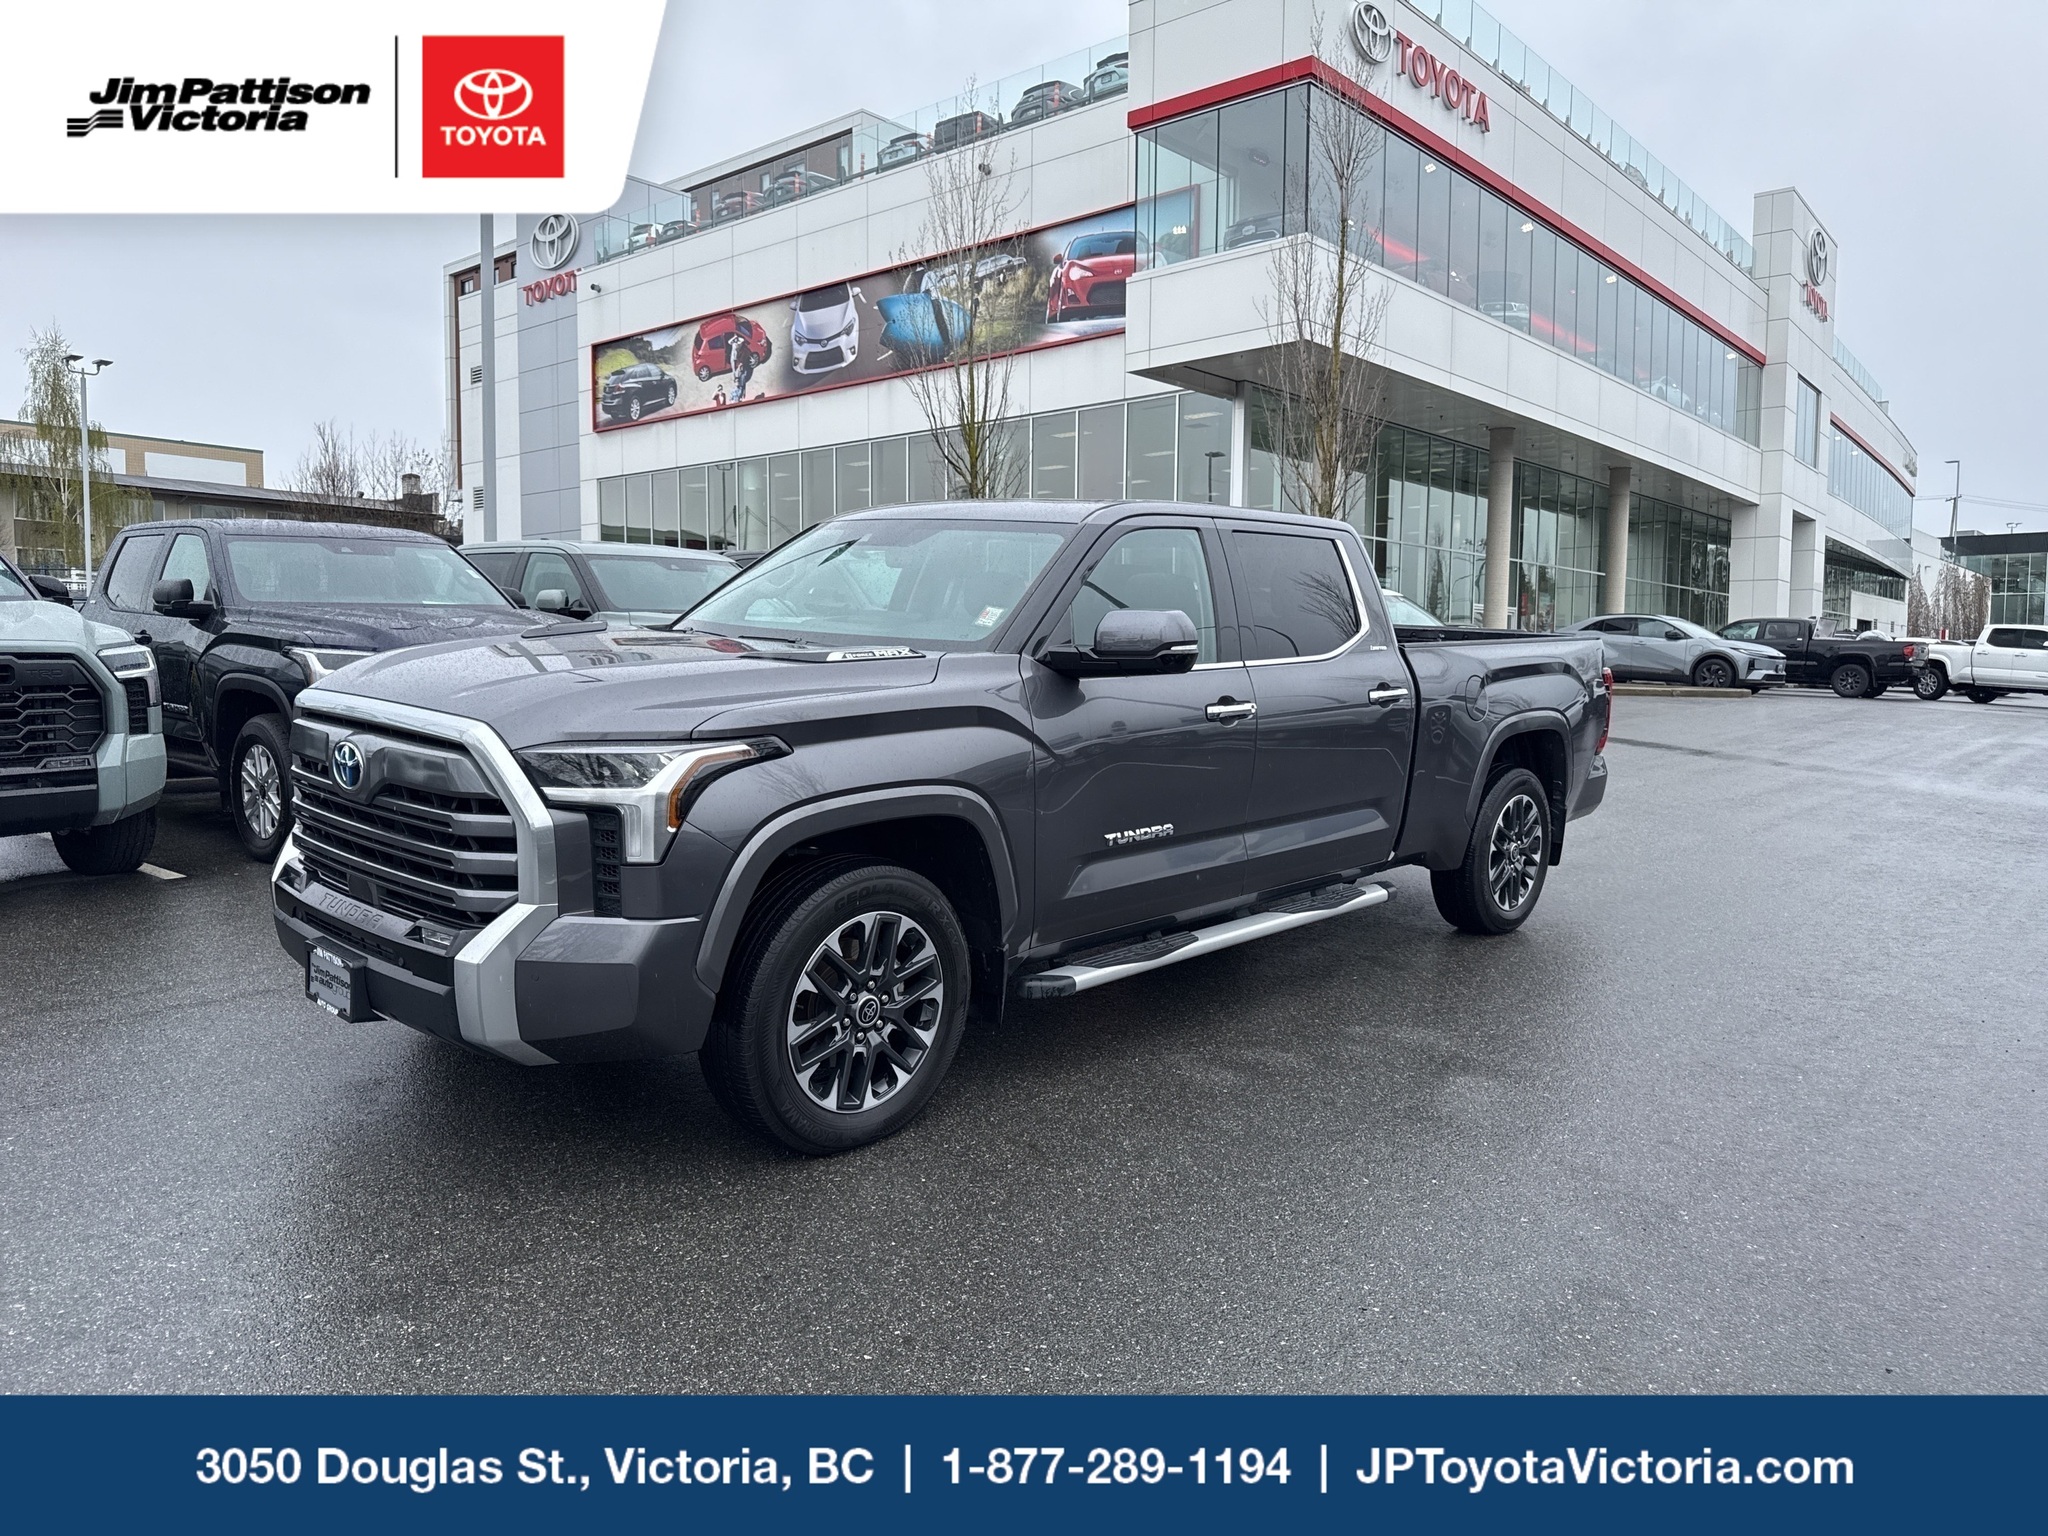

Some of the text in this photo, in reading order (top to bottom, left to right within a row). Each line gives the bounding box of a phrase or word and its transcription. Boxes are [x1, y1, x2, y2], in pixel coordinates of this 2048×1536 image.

[1393, 30, 1490, 133] TOYOTA
[522, 268, 582, 307] TOYOT
[1104, 823, 1174, 846] TUNDRA
[319, 892, 384, 930] TUNDRA
